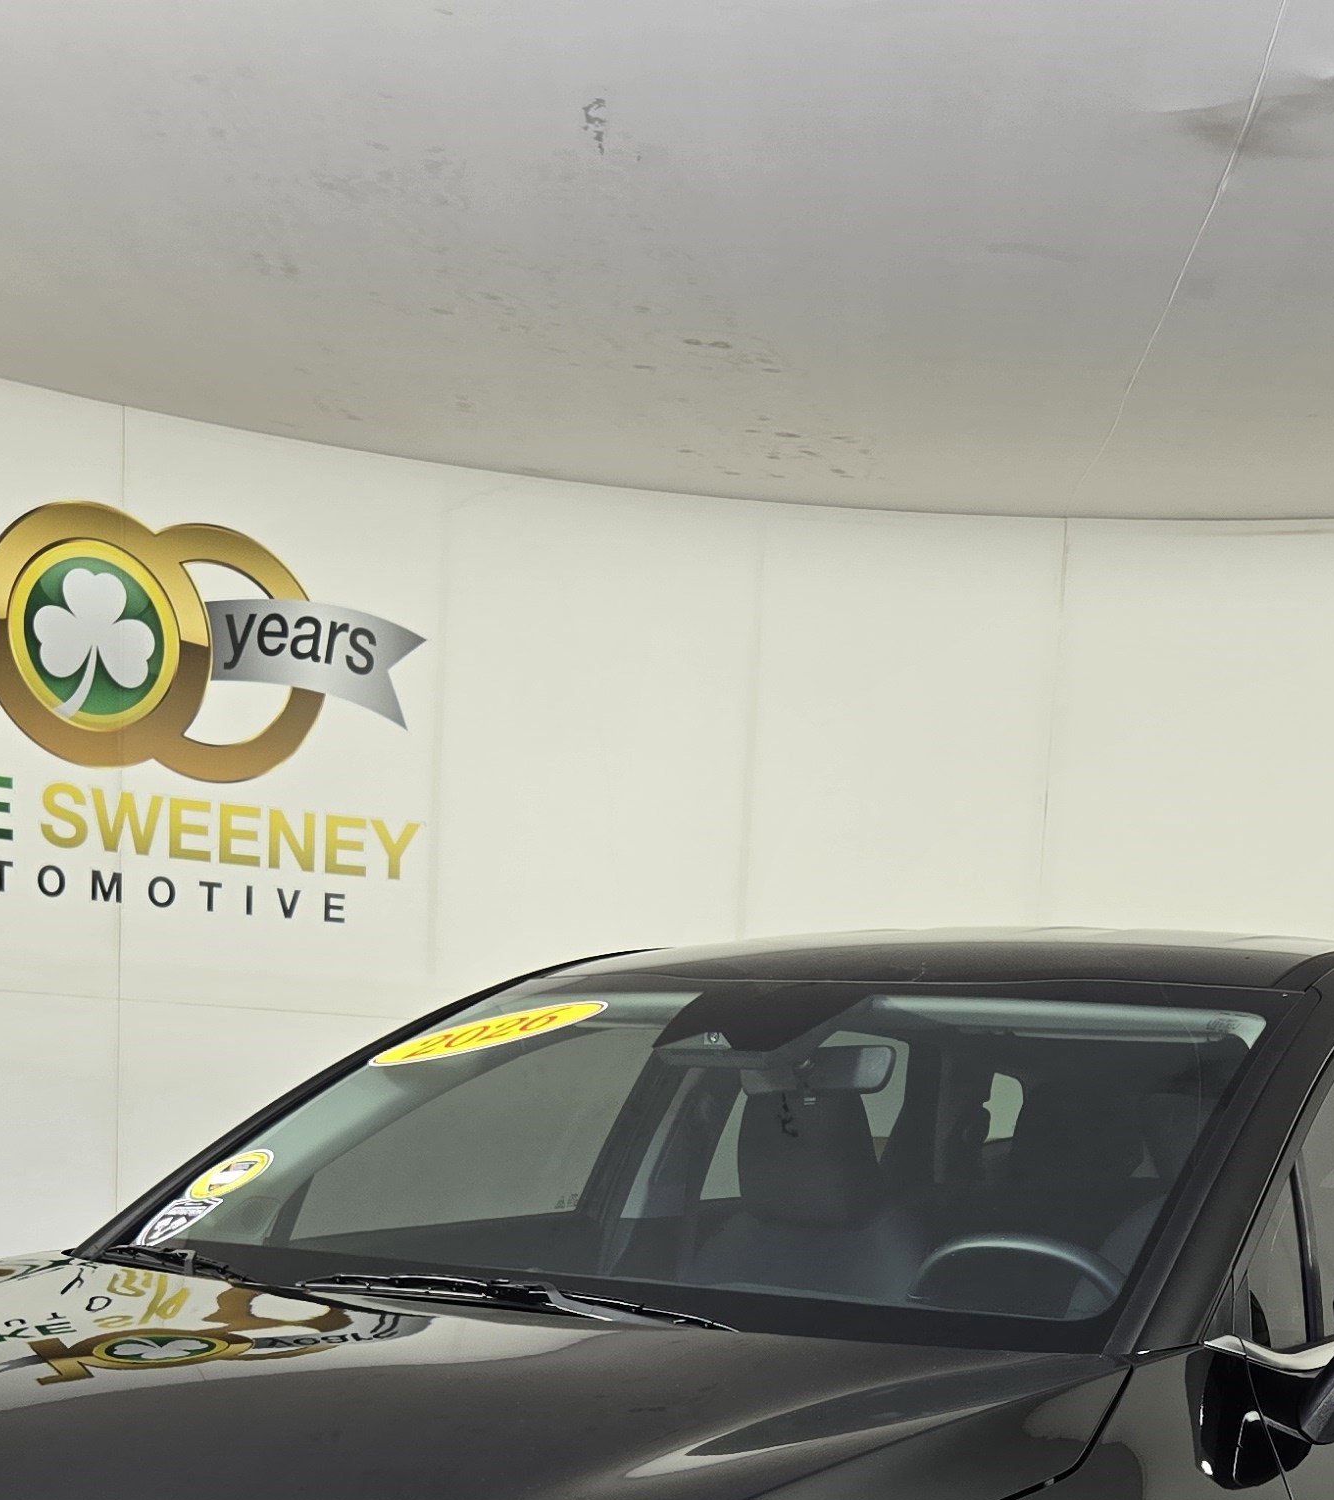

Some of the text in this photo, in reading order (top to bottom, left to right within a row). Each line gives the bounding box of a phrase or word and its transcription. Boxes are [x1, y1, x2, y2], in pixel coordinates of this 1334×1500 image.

[222, 610, 377, 675] years
[40, 781, 420, 881] SWEENEY
[401, 1006, 574, 1060] 2026
